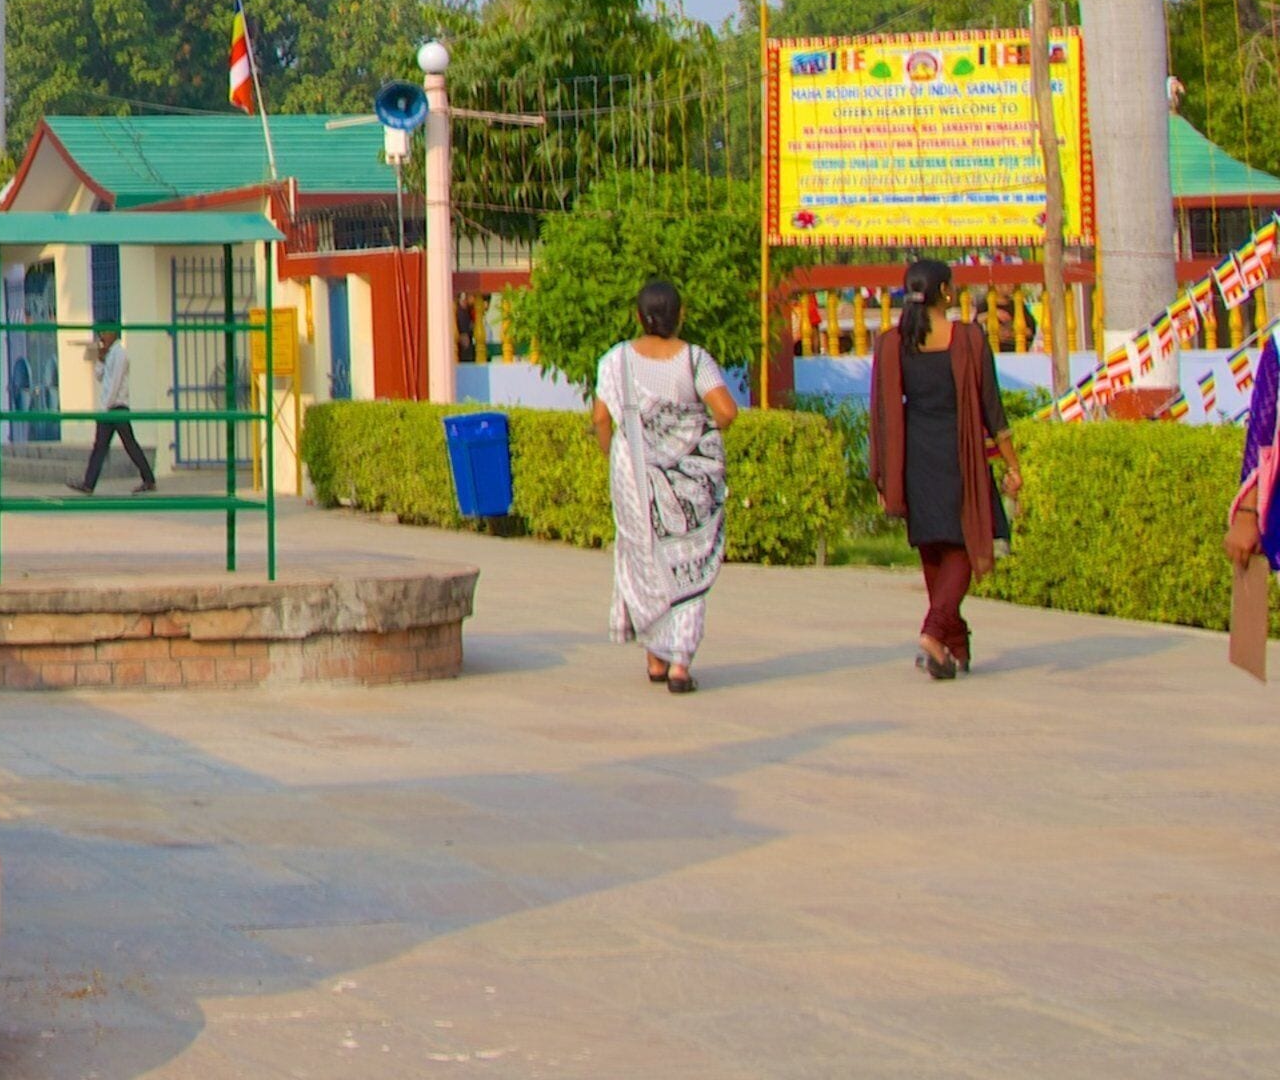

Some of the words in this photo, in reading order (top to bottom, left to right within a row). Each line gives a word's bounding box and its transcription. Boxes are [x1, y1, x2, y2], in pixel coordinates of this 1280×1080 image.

[792, 87, 821, 101] MAHA
[826, 85, 859, 99] BODHI
[864, 84, 905, 98] SOCIETY
[910, 84, 923, 97] OF
[967, 81, 1017, 95] SARNATH
[940, 103, 997, 116] WELCOME
[1003, 102, 1018, 114] TO
